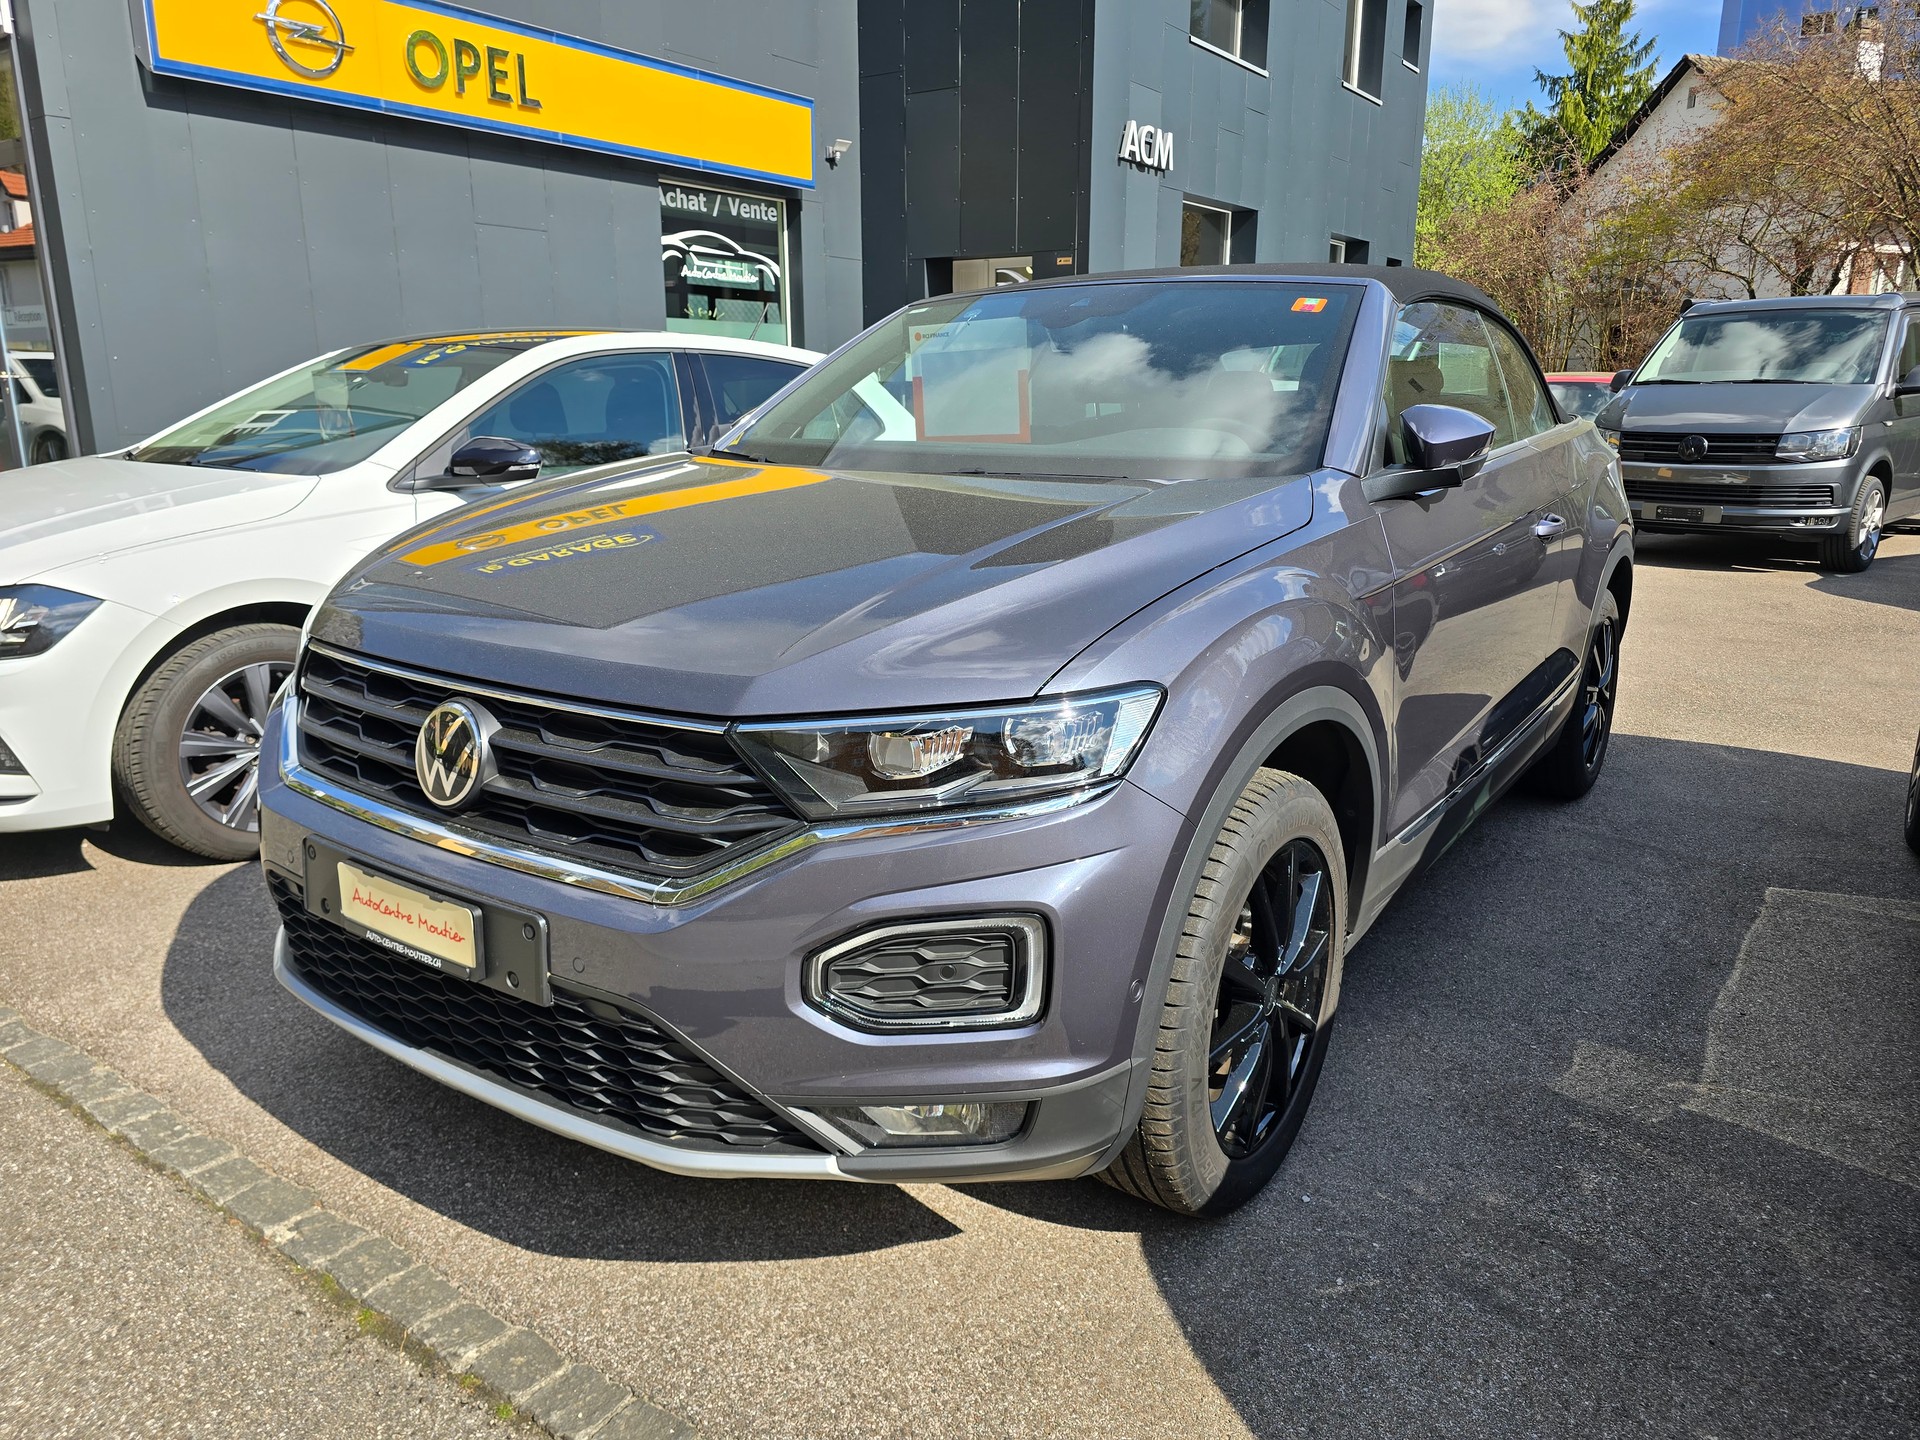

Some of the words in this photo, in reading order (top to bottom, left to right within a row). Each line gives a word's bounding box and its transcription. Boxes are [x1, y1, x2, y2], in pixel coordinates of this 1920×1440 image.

[405, 30, 543, 109] OPEL
[1119, 120, 1173, 171] ACM
[712, 194, 722, 217] /
[727, 197, 778, 222] Vente
[352, 887, 414, 925] AutoCentre
[418, 913, 465, 943] Moutier
